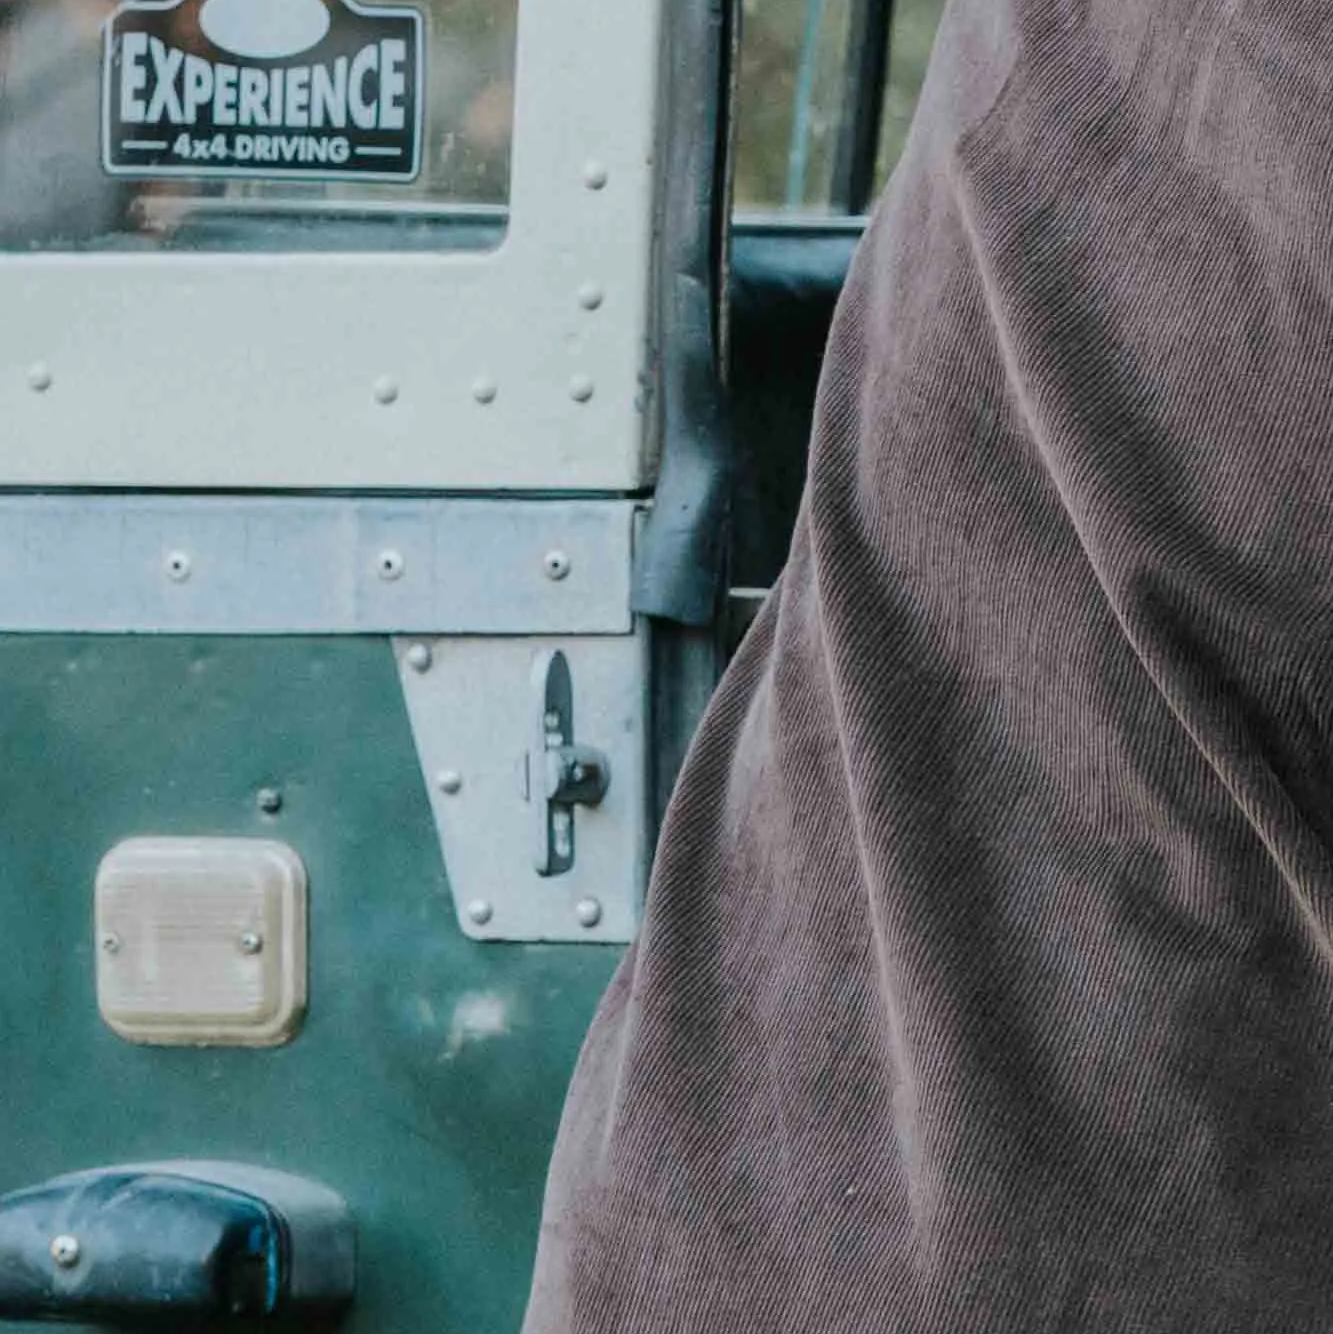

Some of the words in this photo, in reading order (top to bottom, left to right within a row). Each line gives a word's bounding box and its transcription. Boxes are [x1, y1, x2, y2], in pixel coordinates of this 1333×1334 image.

[120, 32, 406, 129] EXPERIENCE
[172, 133, 228, 160] 4x4
[234, 135, 350, 163] DRIVING
